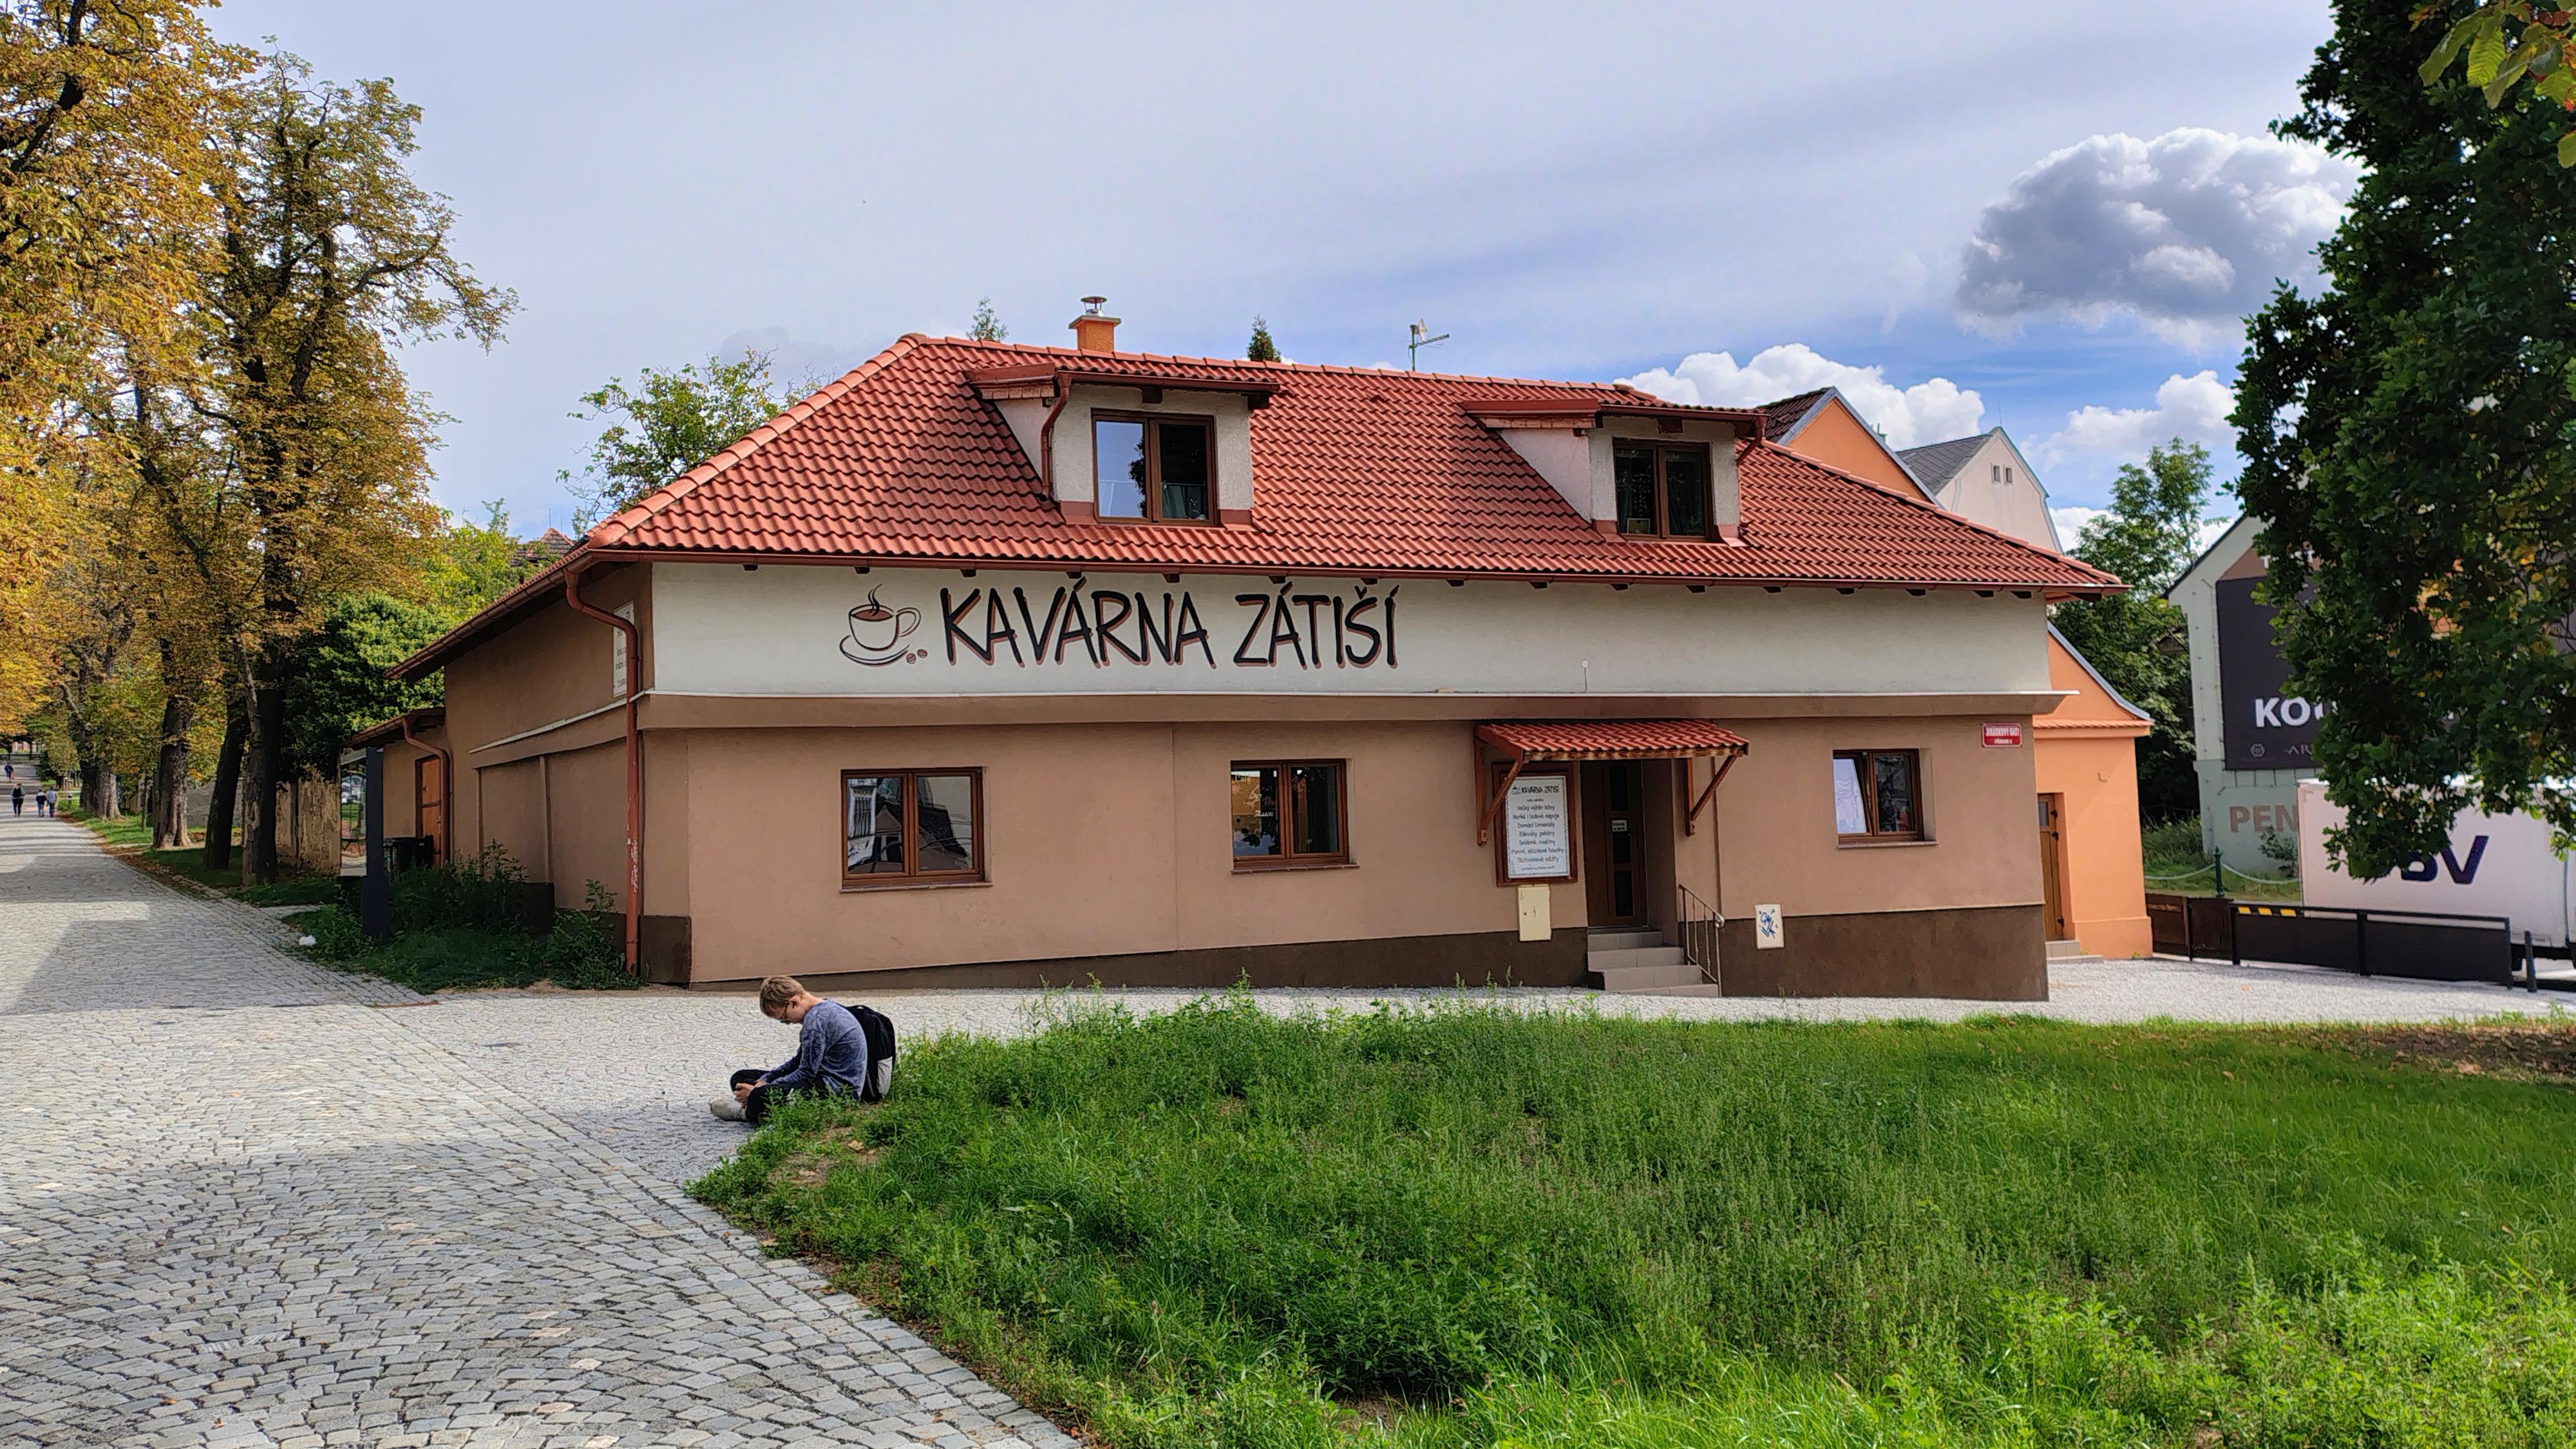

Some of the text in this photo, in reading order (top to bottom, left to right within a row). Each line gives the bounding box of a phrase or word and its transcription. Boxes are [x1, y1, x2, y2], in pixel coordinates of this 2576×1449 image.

[940, 576, 1400, 670] KAVÁRNA ZÁTIŠÍ
[1521, 784, 1559, 794] KAVÁRNA ZÁTIŠÍ
[2388, 835, 2489, 884] BV
